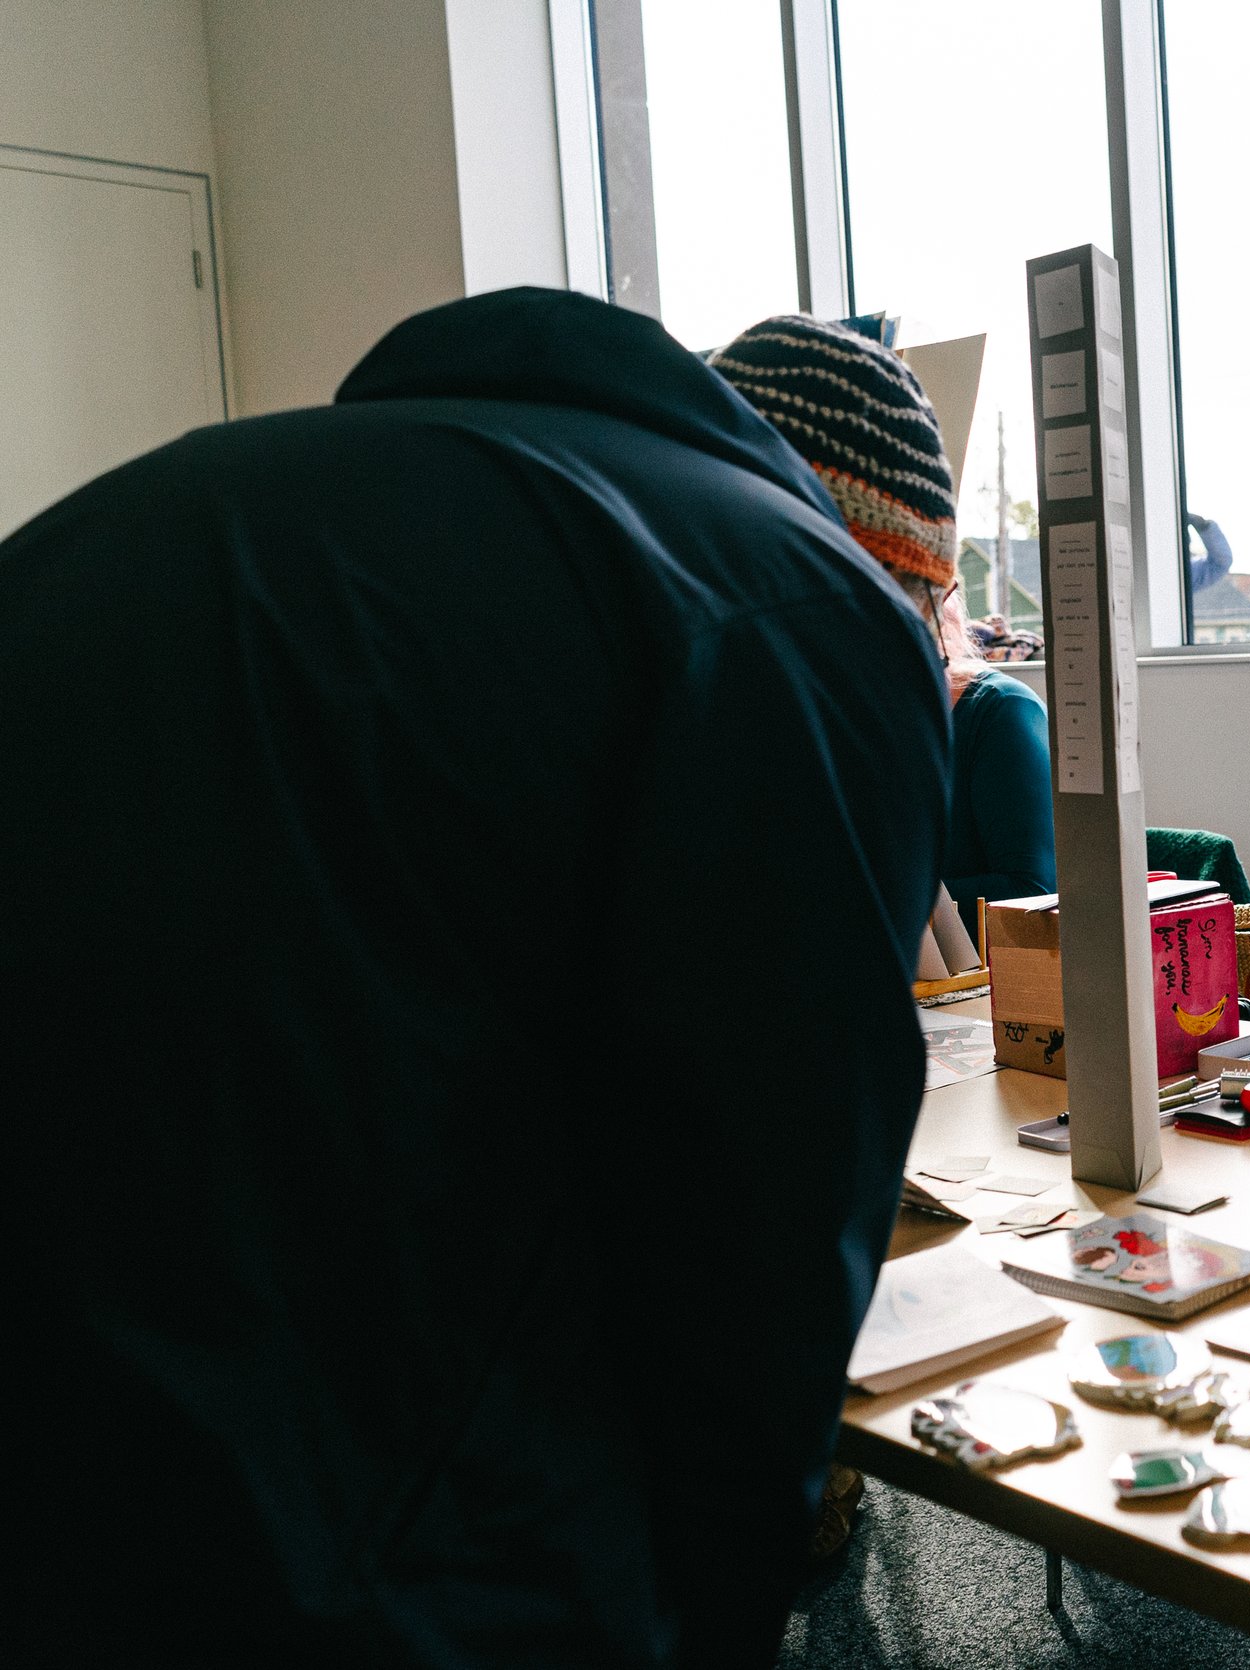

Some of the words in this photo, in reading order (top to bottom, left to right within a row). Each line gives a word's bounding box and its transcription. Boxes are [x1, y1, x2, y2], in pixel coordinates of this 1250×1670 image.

[1154, 927, 1176, 953] for
[1176, 918, 1192, 996] bananas
[1198, 918, 1217, 959] I'm
